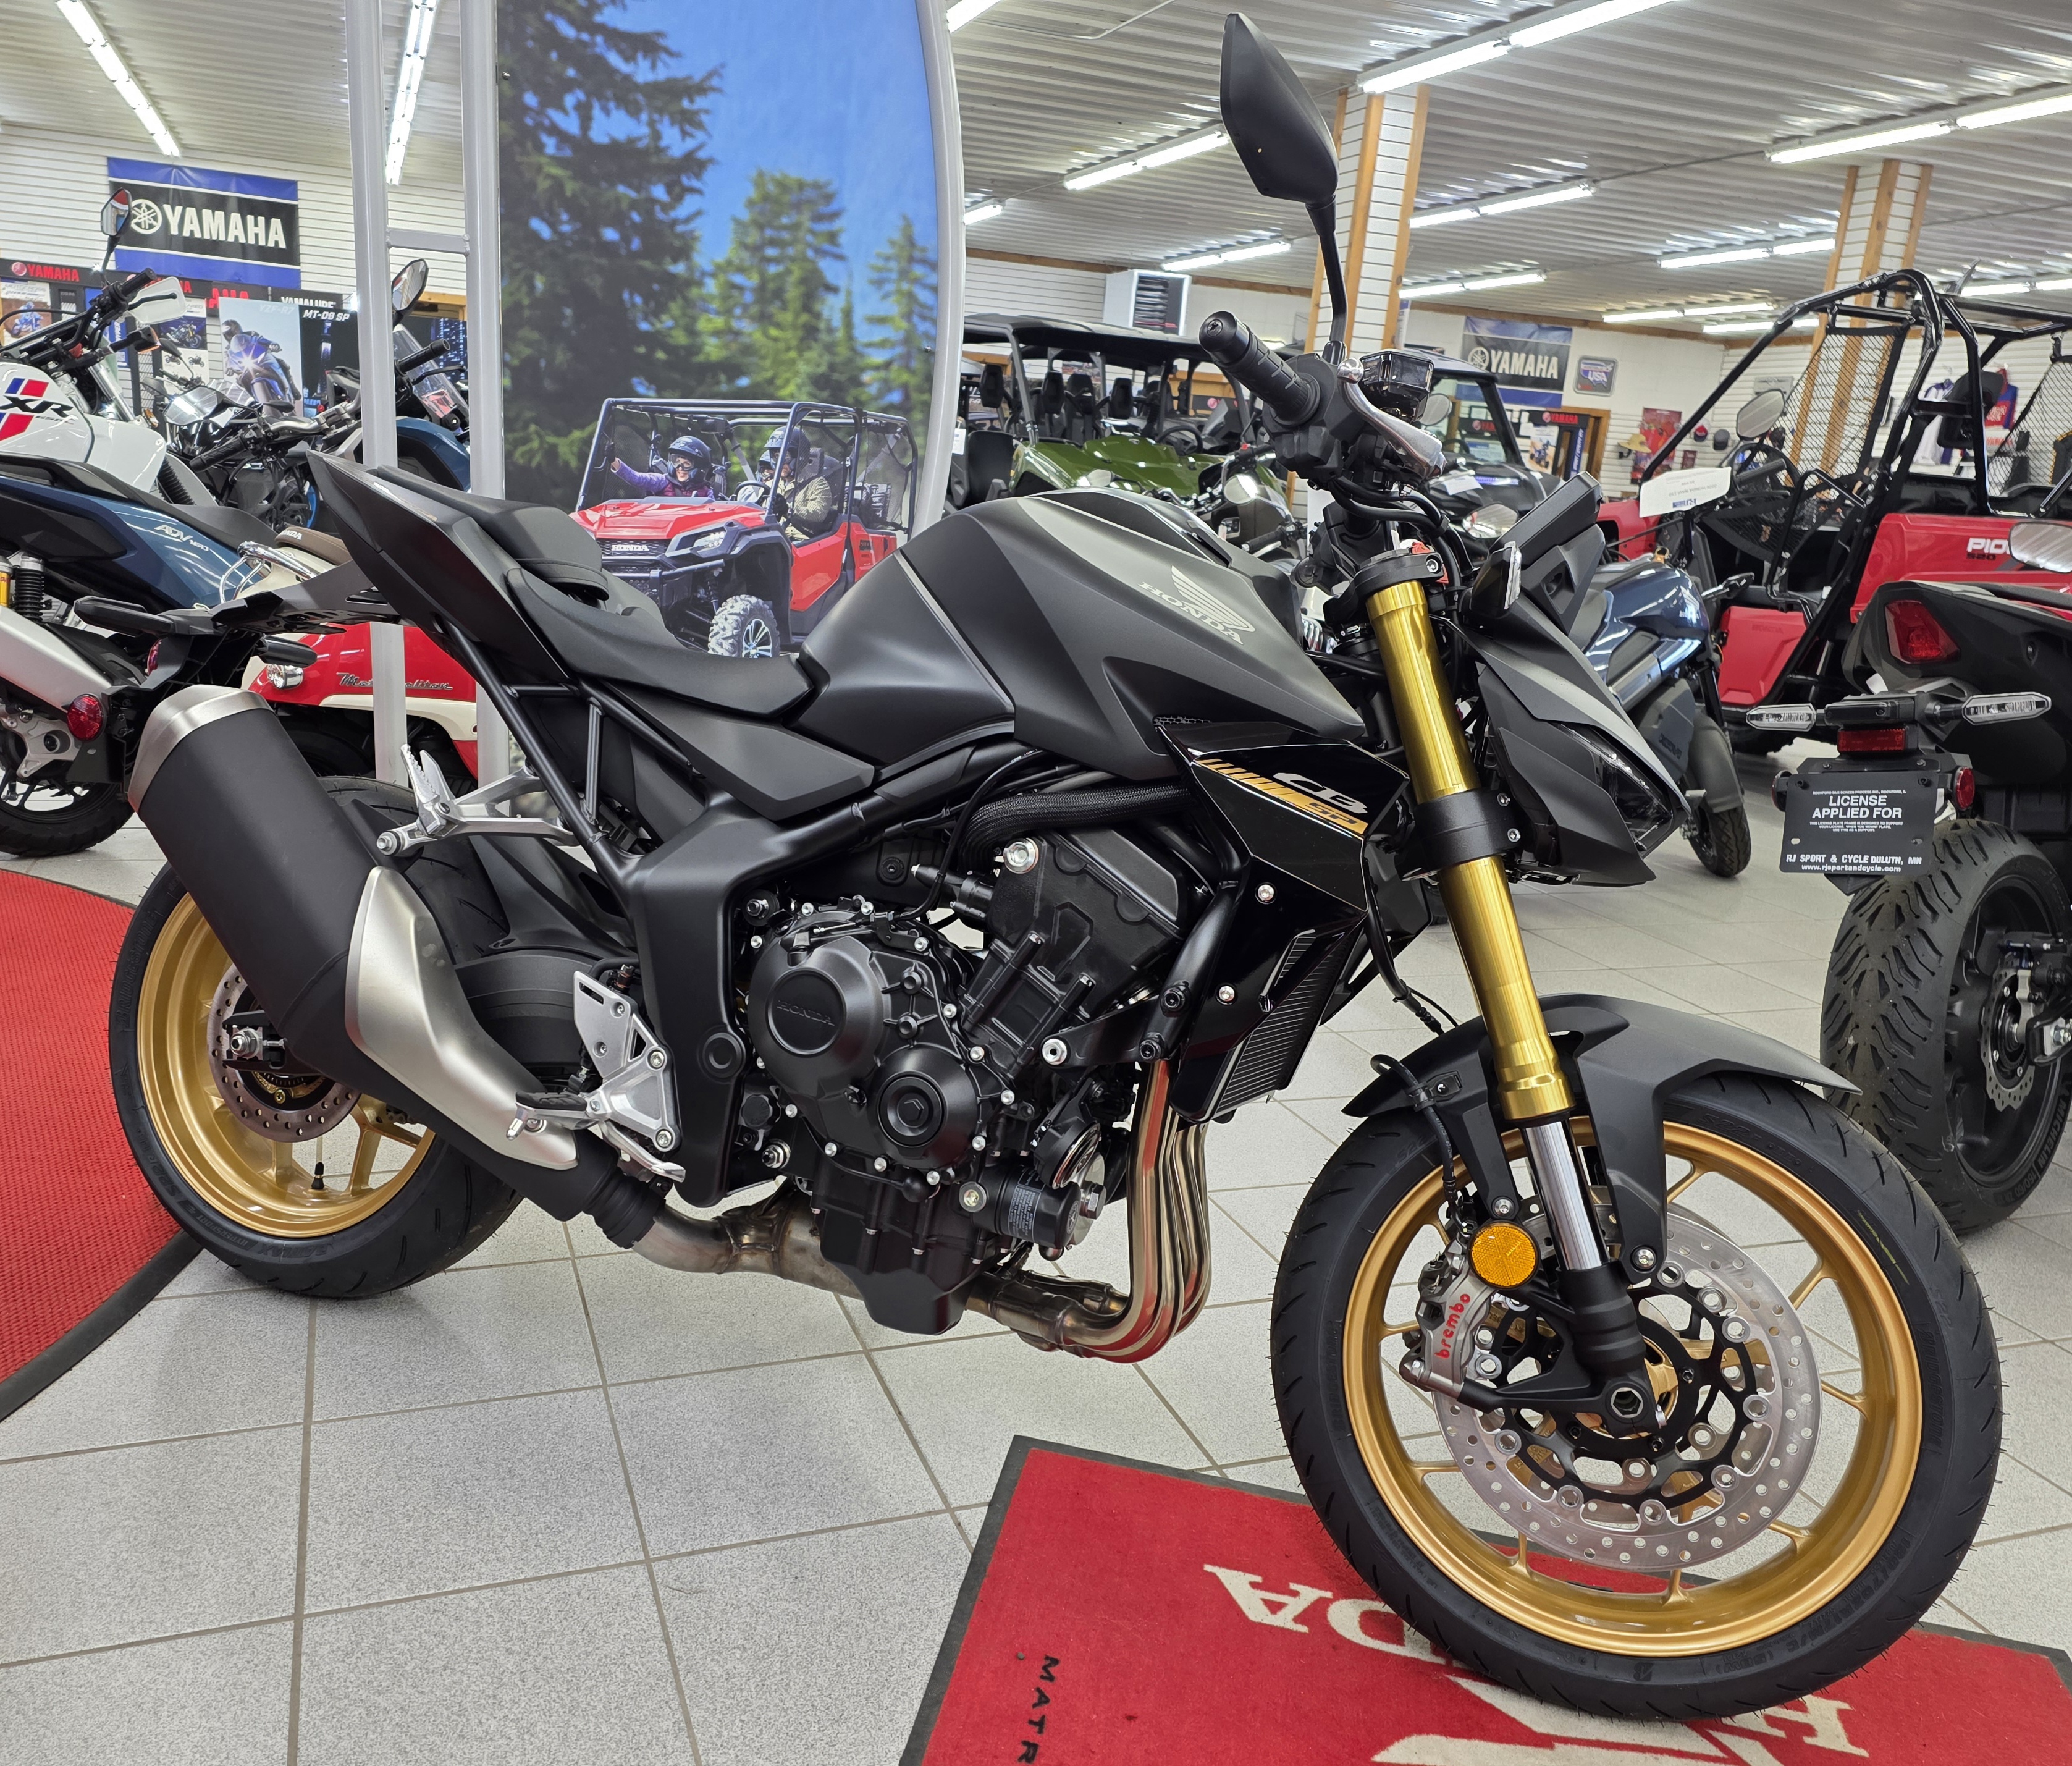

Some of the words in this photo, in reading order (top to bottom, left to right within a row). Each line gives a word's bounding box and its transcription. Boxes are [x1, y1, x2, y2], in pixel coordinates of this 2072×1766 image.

[162, 204, 286, 248] YAMAHA
[27, 264, 80, 282] YAMAHA
[259, 304, 295, 315] YZF-R7
[336, 313, 350, 322] SP
[1491, 350, 1558, 379] YAMAHA
[1588, 371, 1607, 382] USA
[0, 395, 74, 418] XR
[1551, 413, 1578, 424] YAMAHA
[154, 525, 193, 542] ADV
[190, 539, 209, 552] 160
[1137, 581, 1244, 645] HONDA
[336, 672, 453, 690] Metolitan
[1273, 772, 1368, 814] CB
[1829, 795, 1887, 806] LICENSE
[1305, 803, 1358, 824] SP
[1812, 808, 1869, 818] APPLIED
[1873, 808, 1902, 818] FOR
[1786, 854, 1796, 863] RJ
[1800, 855, 1826, 863] SPORT
[1830, 855, 1837, 863] &
[1842, 855, 1869, 863] CYCLE
[1870, 856, 1903, 865] DULUTH,
[1801, 864, 1901, 872] www.rjsportandcycle.com
[777, 1000, 835, 1026] HONDA
[2037, 1098, 2066, 1170] MICHELIN
[195, 1214, 249, 1247] HYPERSPORT
[1434, 1293, 1471, 1359] brembo
